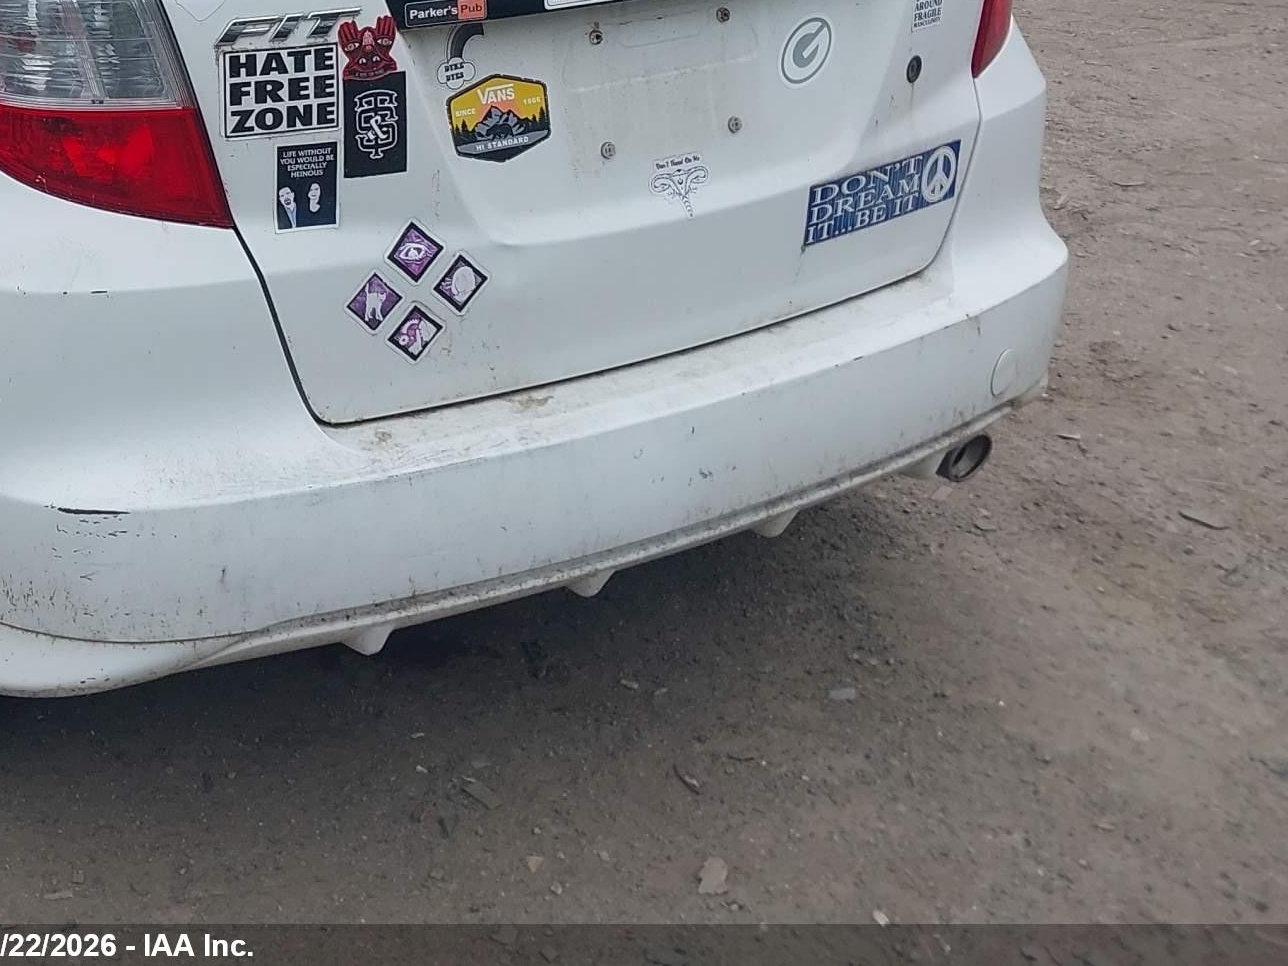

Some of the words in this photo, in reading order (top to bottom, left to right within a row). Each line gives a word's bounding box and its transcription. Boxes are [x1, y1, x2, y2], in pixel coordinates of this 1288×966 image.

[409, 5, 458, 20] Parker's
[460, 2, 483, 14] Pub
[914, 7, 942, 22] FRAGILE
[215, 7, 361, 45] FIT
[229, 47, 334, 79] HATE
[229, 74, 335, 107] FREE
[477, 84, 516, 105] VANS
[229, 101, 336, 134] ZONE
[455, 107, 476, 117] SINCE
[282, 150, 297, 158] LIFE
[297, 147, 332, 157] WITHOUT
[476, 143, 485, 152] HI
[487, 136, 530, 151] STANDARD
[287, 162, 328, 172] ESPECIALLY
[296, 155, 325, 164] WOULD
[290, 169, 324, 178] HEINOUS
[812, 155, 923, 206] DON'T
[809, 174, 920, 225] DREAM
[892, 191, 919, 217] IT
